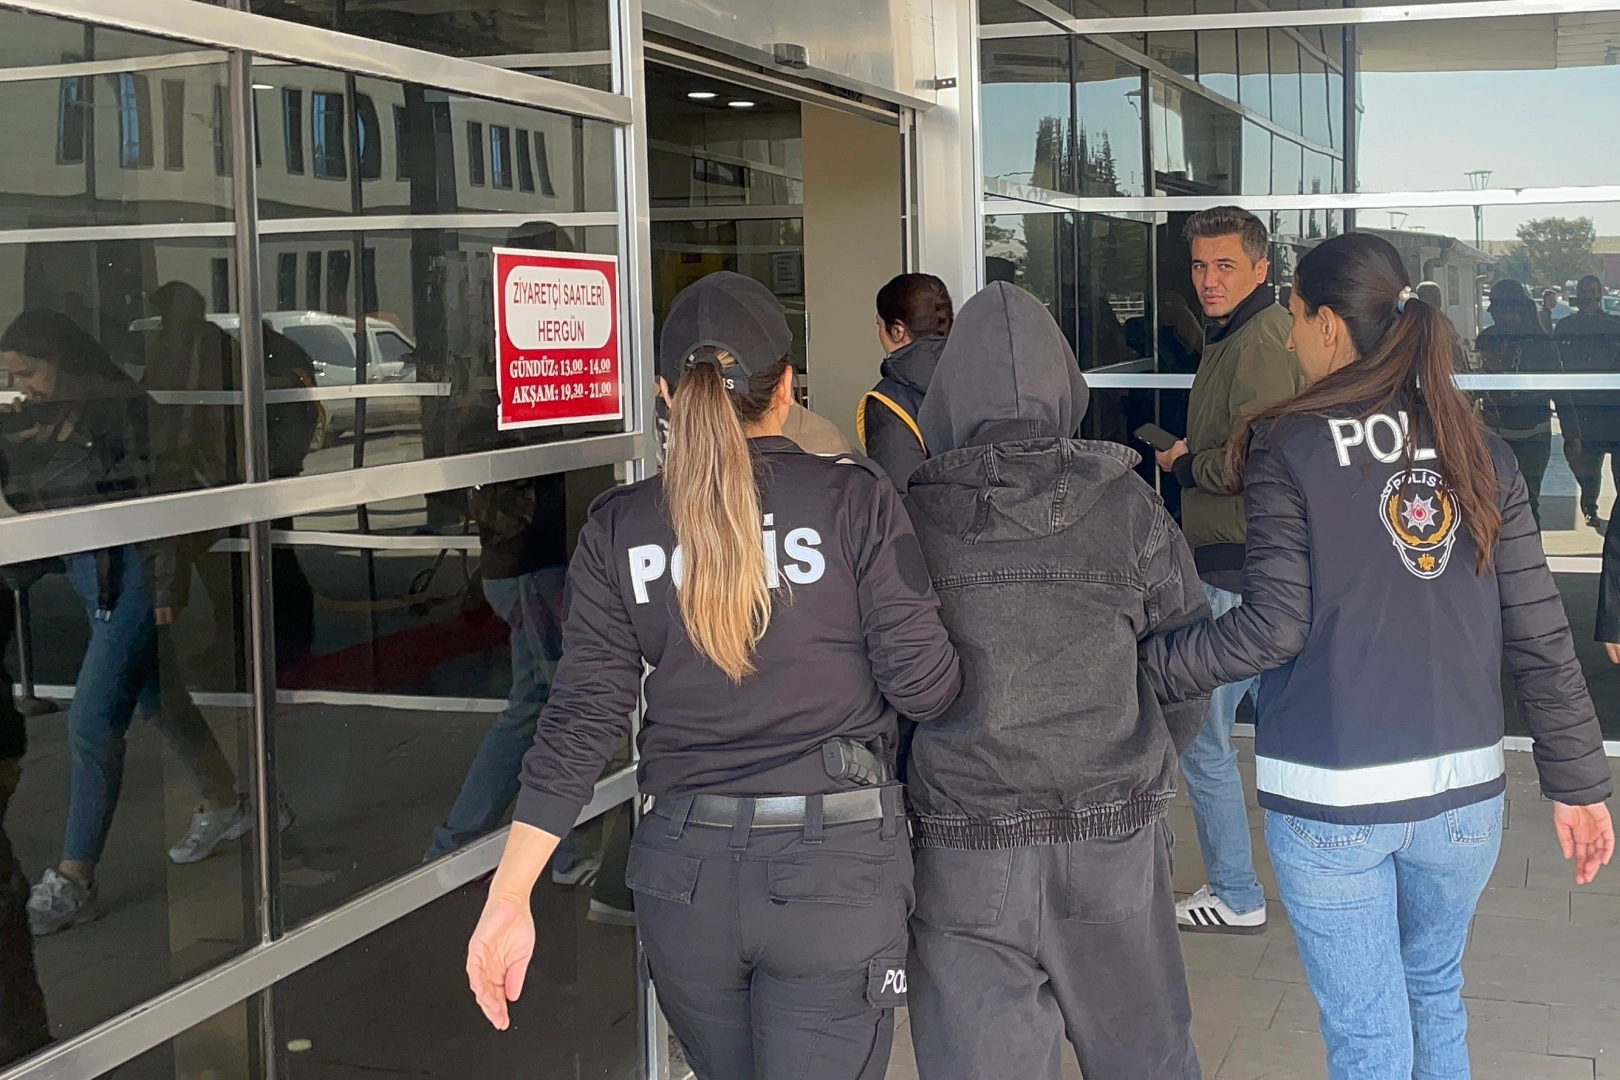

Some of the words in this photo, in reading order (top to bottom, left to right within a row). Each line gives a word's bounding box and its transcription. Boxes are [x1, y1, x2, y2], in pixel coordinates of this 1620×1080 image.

[513, 276, 561, 311] ZİYARETÇİ
[563, 280, 605, 306] SAATLERİ
[538, 315, 585, 342] HERGÜN
[509, 355, 559, 379] GÜNDÜZ:
[560, 358, 584, 376] 13.00
[589, 357, 612, 375] 14.00
[511, 383, 559, 409] AKŞAM:
[560, 383, 584, 400] 19.30
[589, 381, 612, 399] 21.00
[628, 512, 826, 605] PİS
